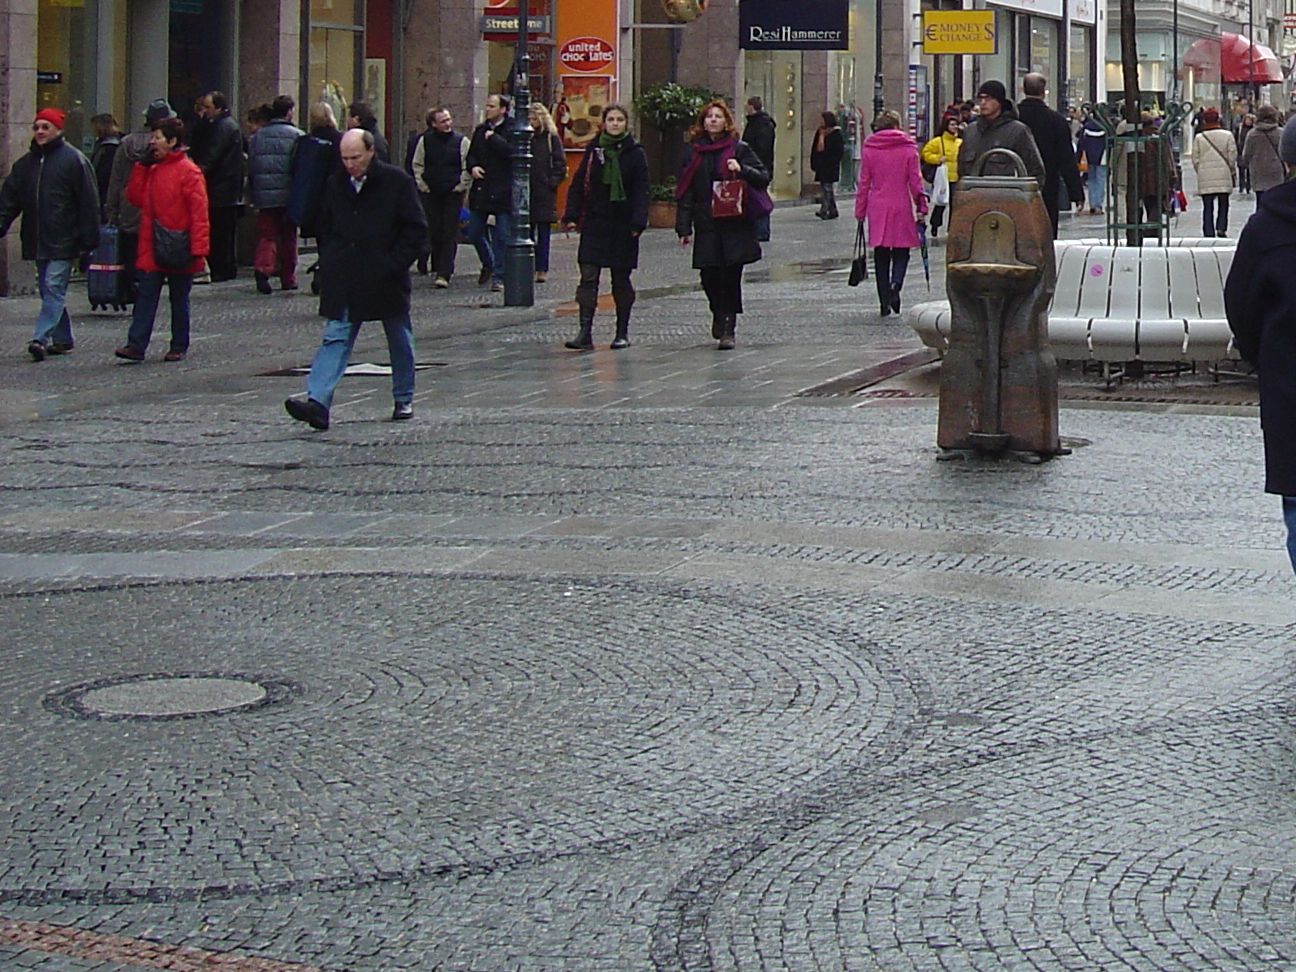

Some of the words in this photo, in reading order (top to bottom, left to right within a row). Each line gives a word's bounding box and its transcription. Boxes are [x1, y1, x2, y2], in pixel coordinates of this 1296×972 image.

[485, 19, 520, 29] Street
[939, 23, 982, 33] MONEY
[750, 26, 780, 41] Resi
[782, 26, 841, 41] Hammerer
[939, 33, 983, 42] CHANGE
[568, 42, 600, 51] united
